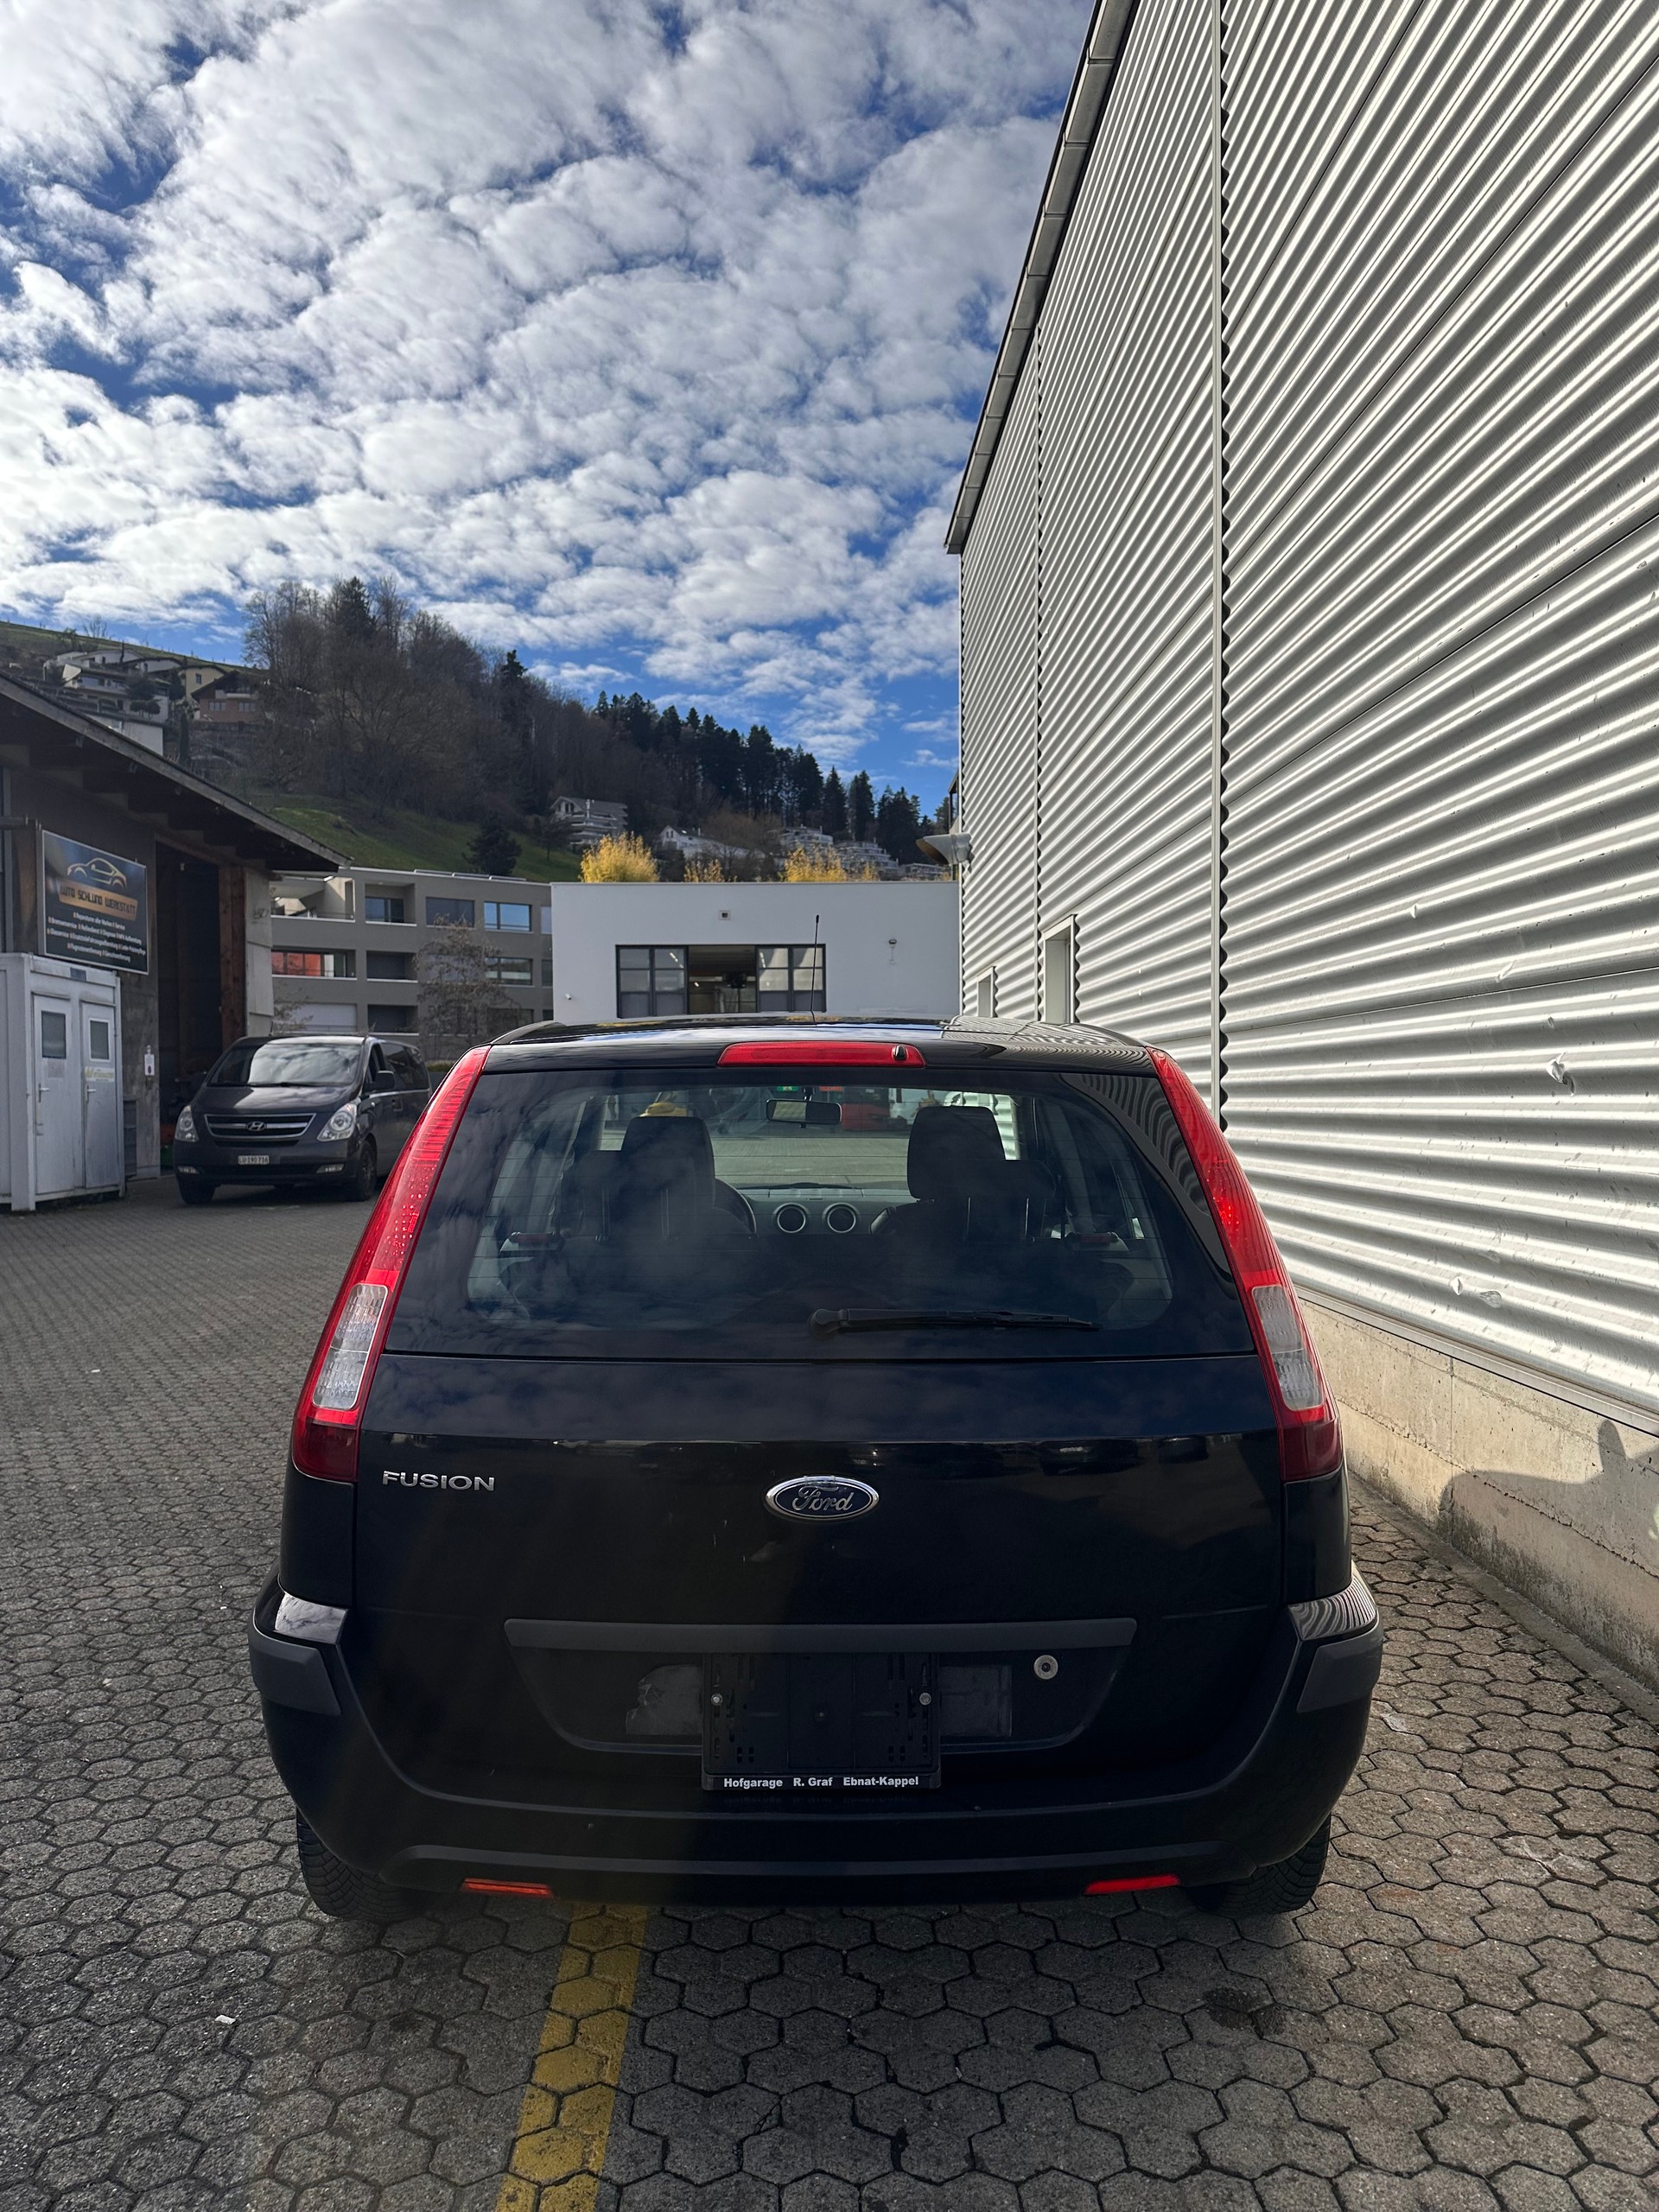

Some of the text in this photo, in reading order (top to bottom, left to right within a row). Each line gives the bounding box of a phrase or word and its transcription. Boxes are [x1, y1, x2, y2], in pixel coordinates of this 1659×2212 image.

[105, 897, 137, 914] WERKSTATT
[383, 1471, 495, 1491] FUSION
[792, 1485, 854, 1510] Ford
[723, 1777, 918, 1789] Hofgarage R. Graf Ebnat-Kappel
